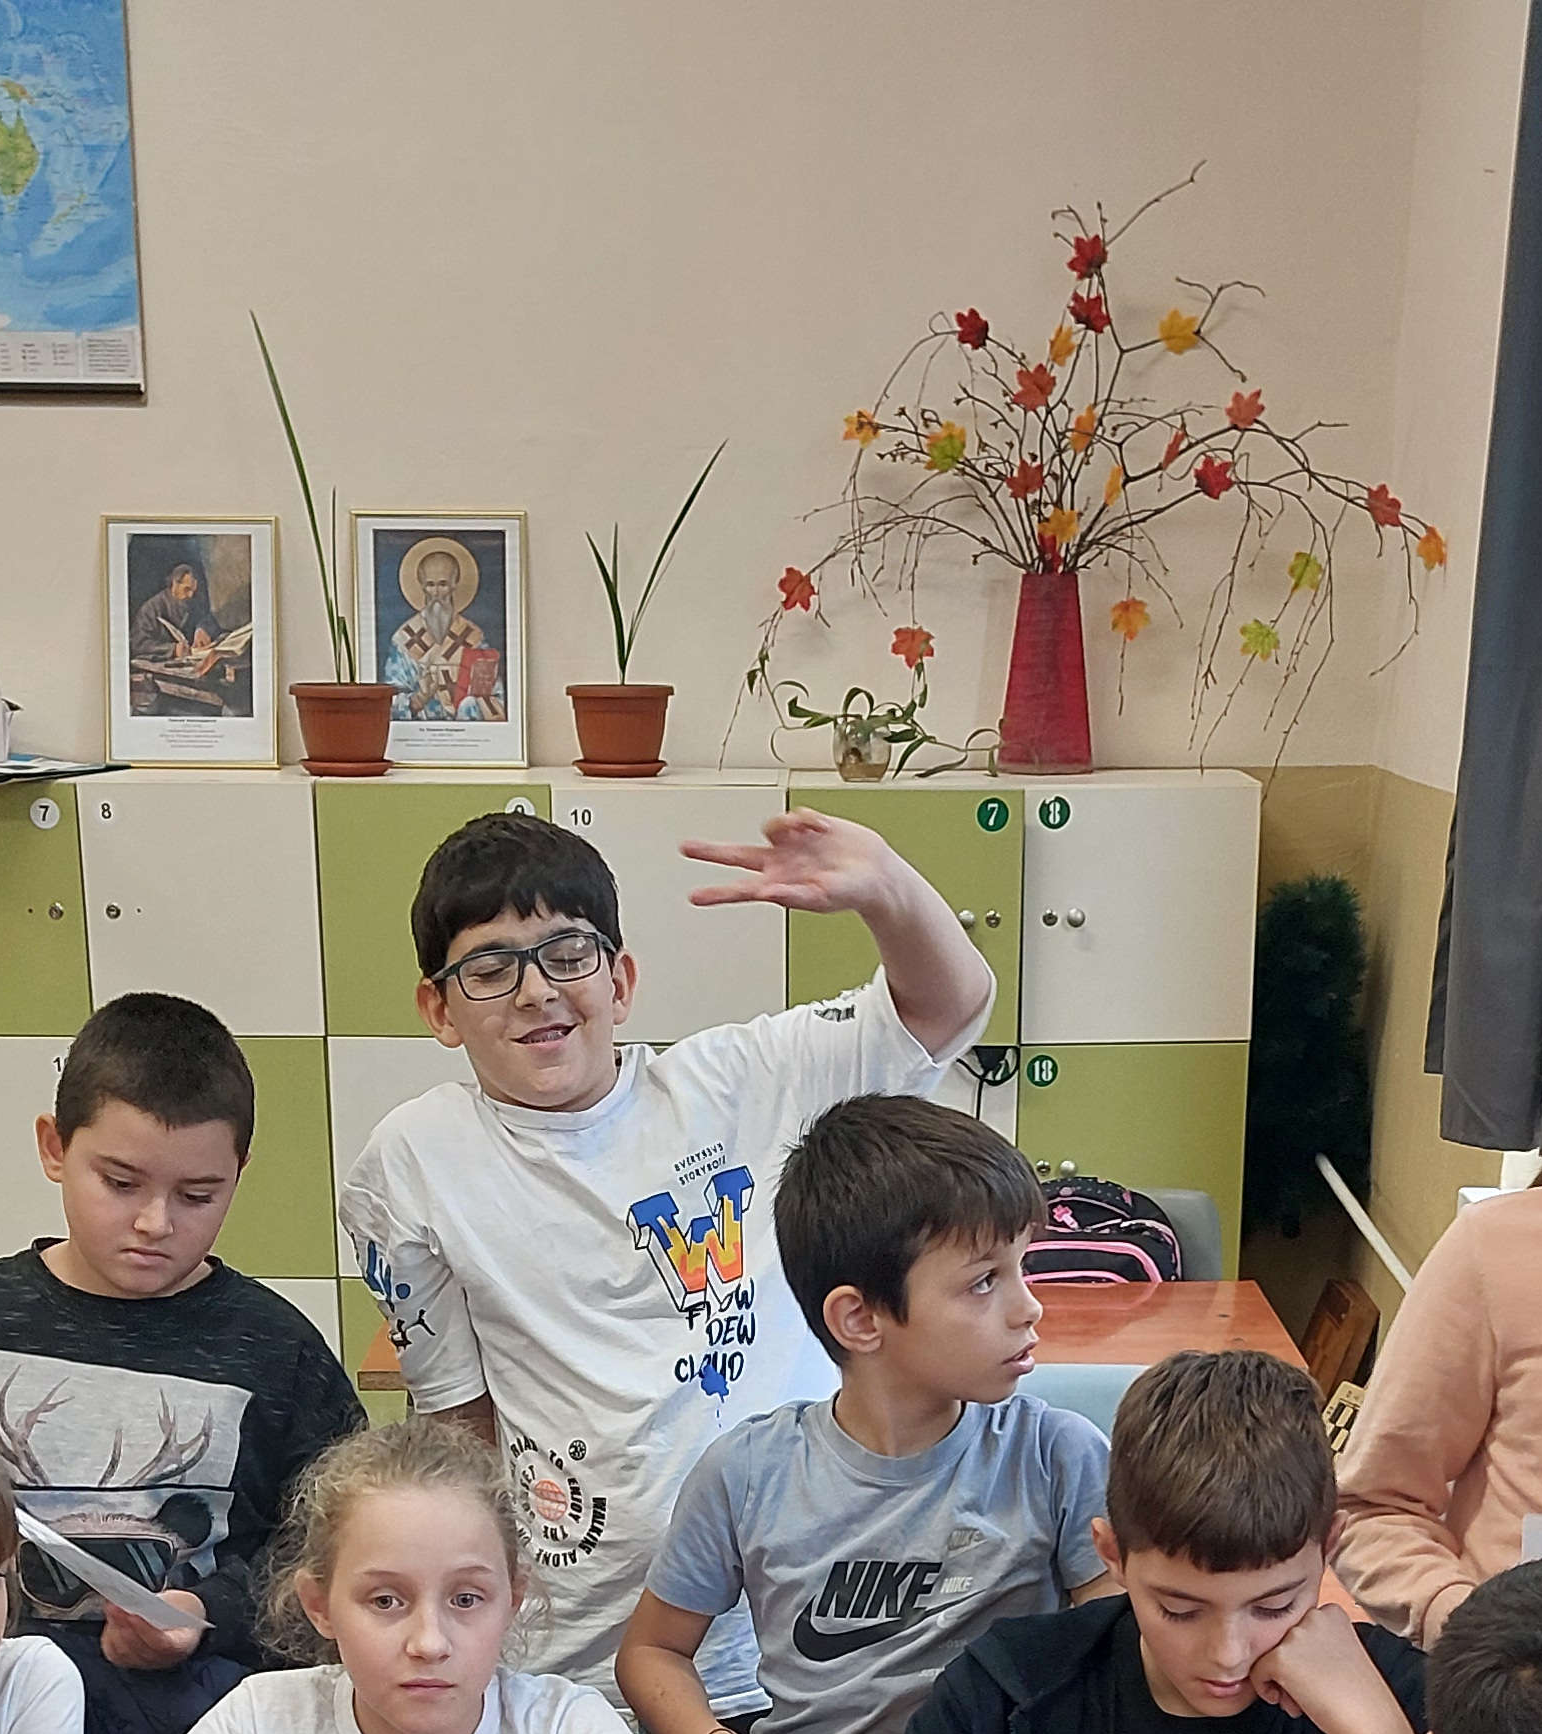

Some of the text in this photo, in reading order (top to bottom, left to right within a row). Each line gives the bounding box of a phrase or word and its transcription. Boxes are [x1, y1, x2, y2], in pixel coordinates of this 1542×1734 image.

[38, 804, 50, 822] 7
[101, 802, 112, 819] 8
[570, 809, 592, 826] 10
[987, 803, 999, 827] 7
[1048, 801, 1061, 825] 8
[52, 1056, 67, 1073] 1
[1033, 1059, 1053, 1082] 18
[707, 1313, 755, 1346] DEW
[567, 1477, 583, 1524] ENJOY
[578, 1497, 607, 1555] WALKING
[948, 1530, 981, 1546] NIKE
[535, 1548, 578, 1567] ALONE
[815, 1560, 943, 1620] NIKE
[940, 1576, 974, 1594] NIKE
